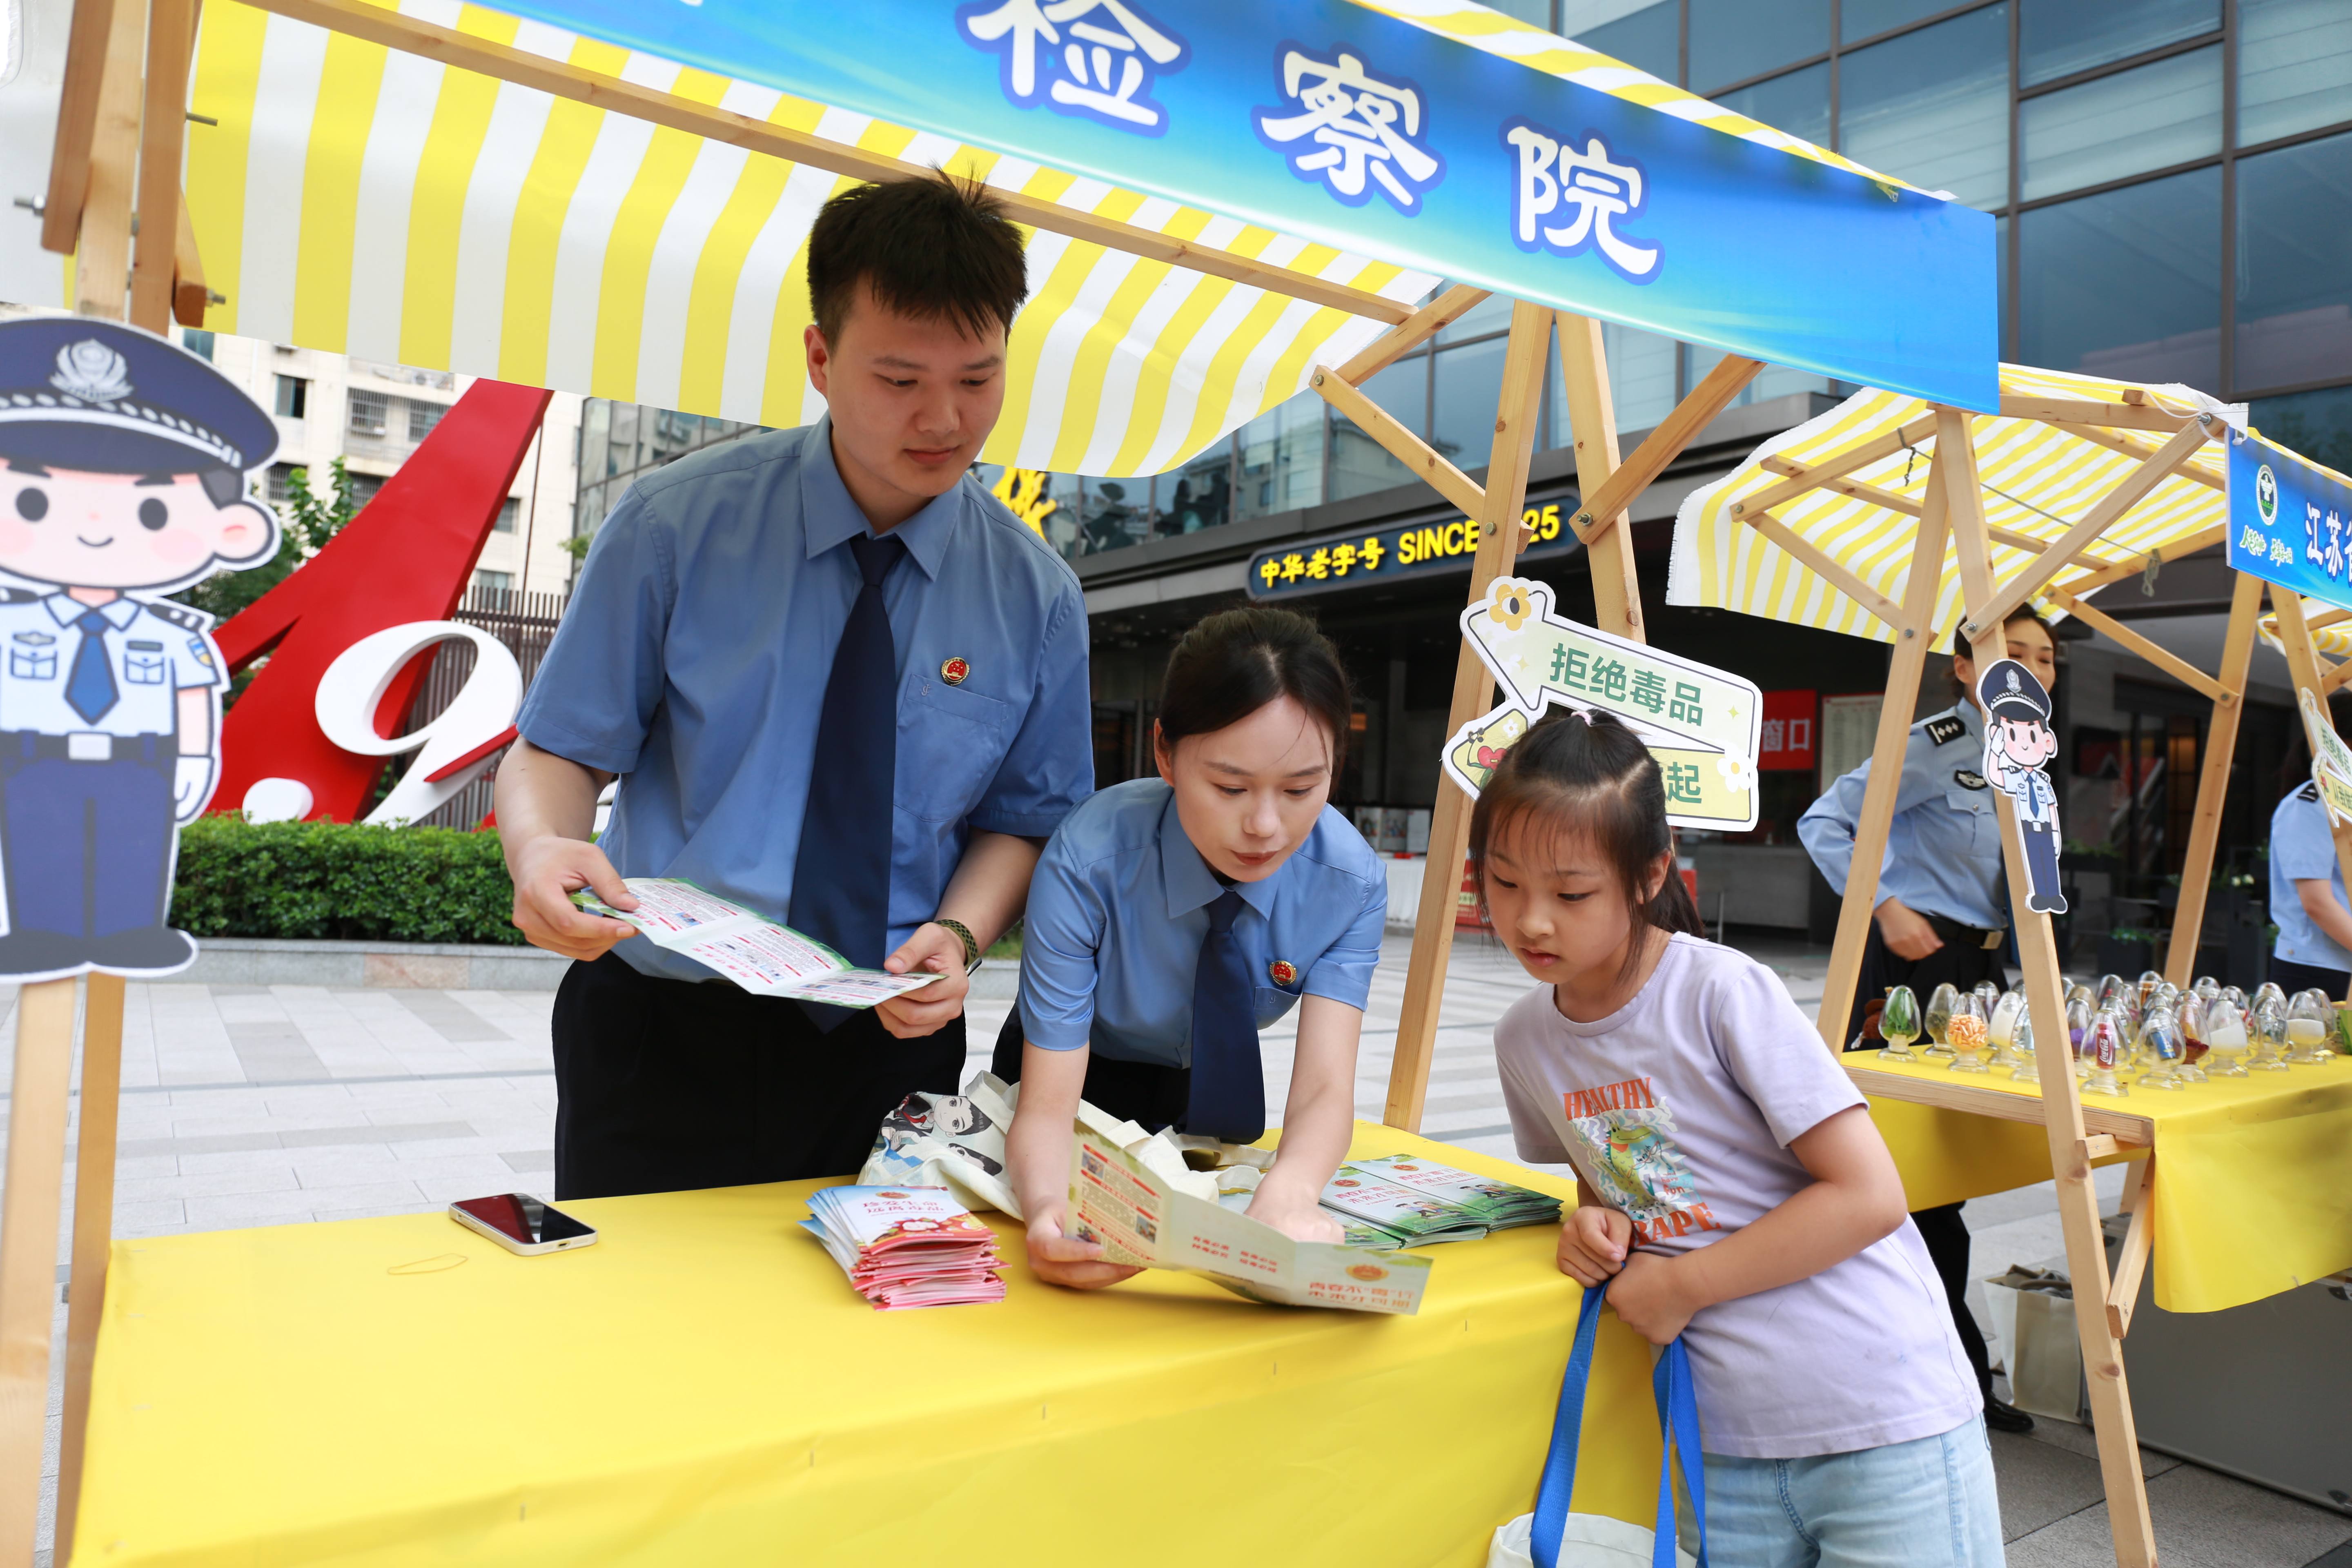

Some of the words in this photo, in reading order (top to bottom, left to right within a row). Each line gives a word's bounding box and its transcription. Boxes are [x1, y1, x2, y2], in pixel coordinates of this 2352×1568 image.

[967, 0, 1658, 274] 检察院
[1261, 537, 1385, 588] 中华老字号
[1398, 519, 1480, 564] SINCE
[1550, 642, 1703, 726] 拒绝毒品
[1659, 762, 1702, 804] 起
[1563, 1077, 1655, 1121] HEALTHY
[1663, 1184, 1685, 1195] fun
[1629, 1202, 1722, 1247] RAPE
